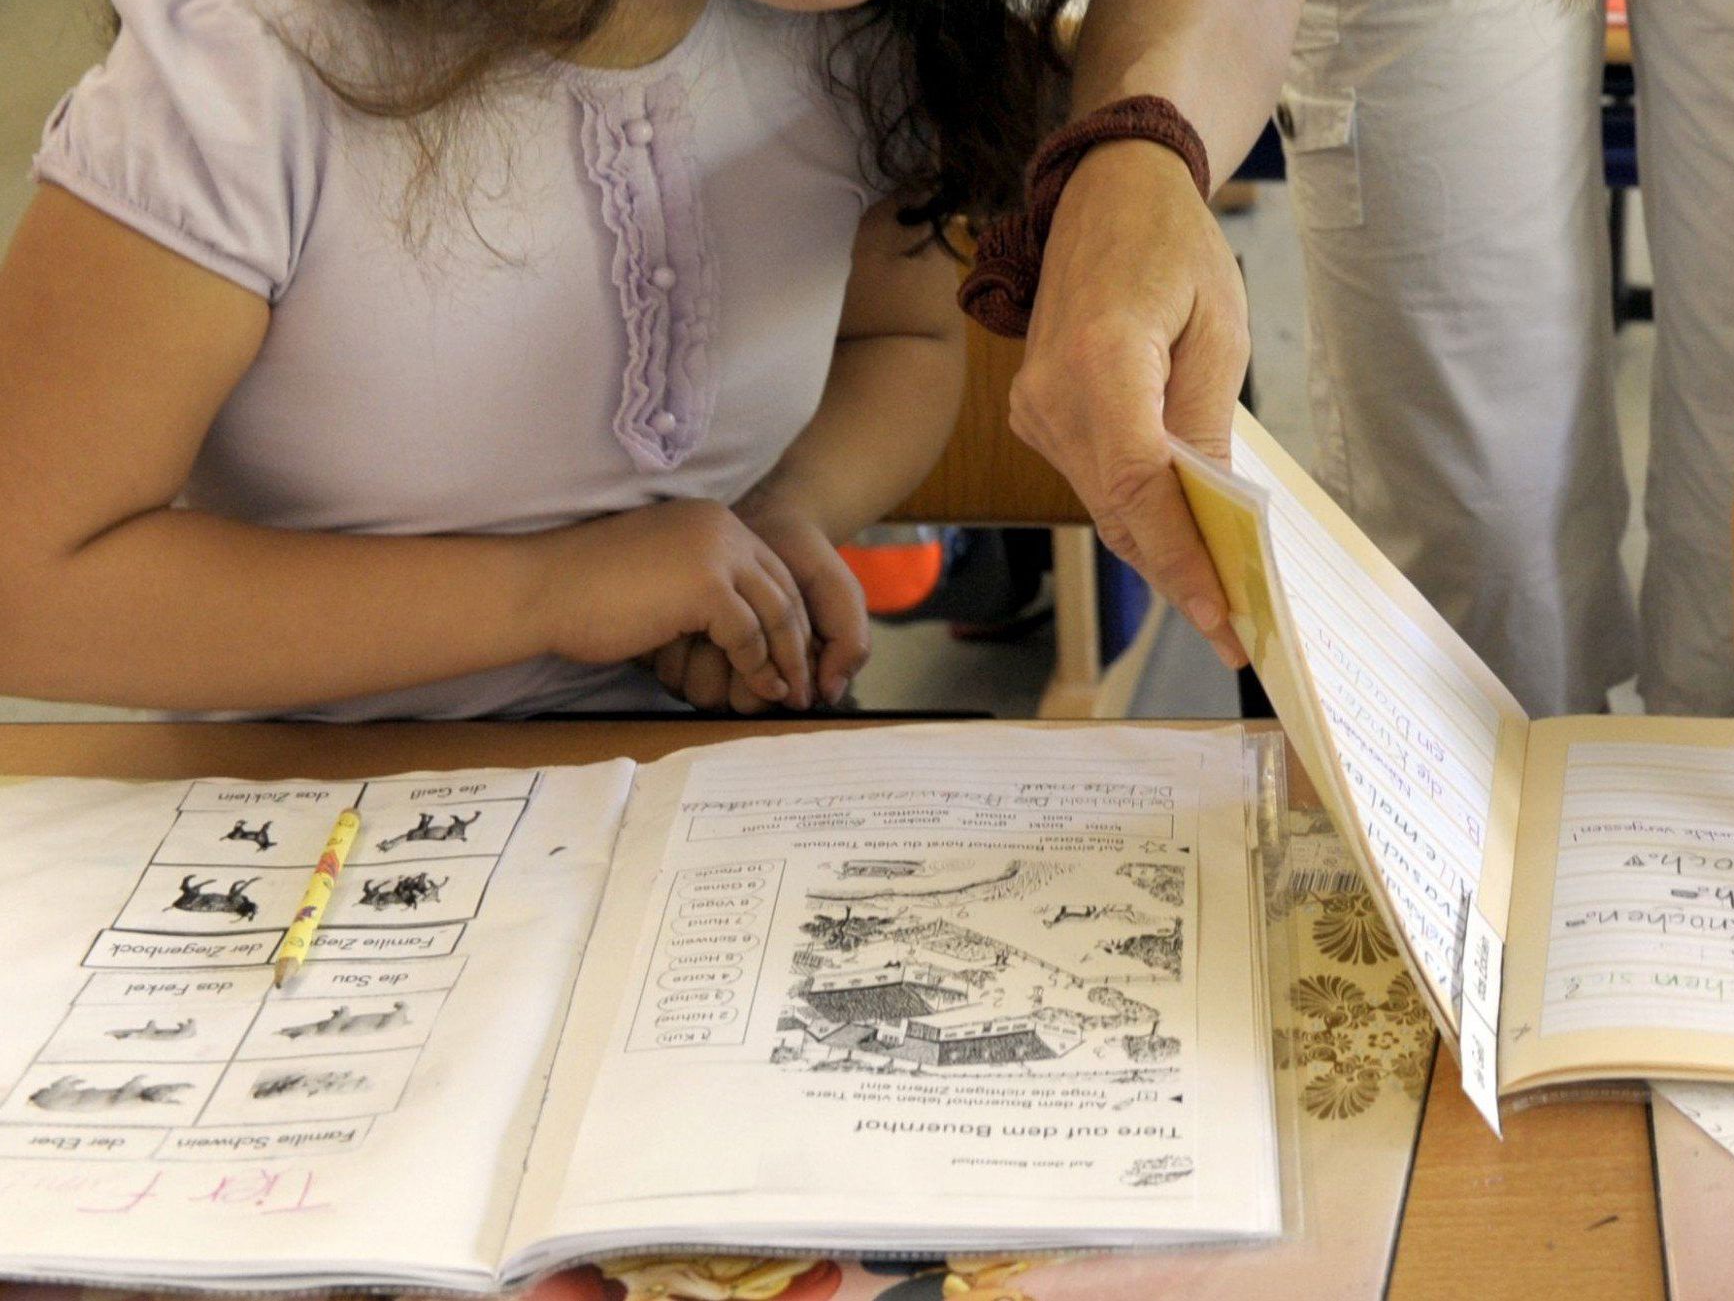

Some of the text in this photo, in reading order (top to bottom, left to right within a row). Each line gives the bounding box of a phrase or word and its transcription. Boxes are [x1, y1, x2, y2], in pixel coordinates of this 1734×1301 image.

[217, 790, 330, 804] das Zicklein
[460, 783, 487, 797] die
[109, 940, 264, 958] der Ziegenbock
[362, 936, 435, 950] Familie
[332, 972, 409, 986] die Sau
[125, 980, 234, 996] das Ferkel
[896, 1084, 950, 1095] Ziffern
[954, 1085, 1026, 1098] richtigen
[1031, 1089, 1056, 1098] die
[1059, 1088, 1108, 1099] Trage
[946, 1099, 1032, 1109] Bauernhof
[1037, 1100, 1074, 1109] dem
[1078, 1100, 1107, 1109] Auf
[854, 1120, 1183, 1140] Tiere auf dem Bauernhof
[29, 1137, 126, 1151] der Eber
[177, 1129, 357, 1151] Familie Schwein
